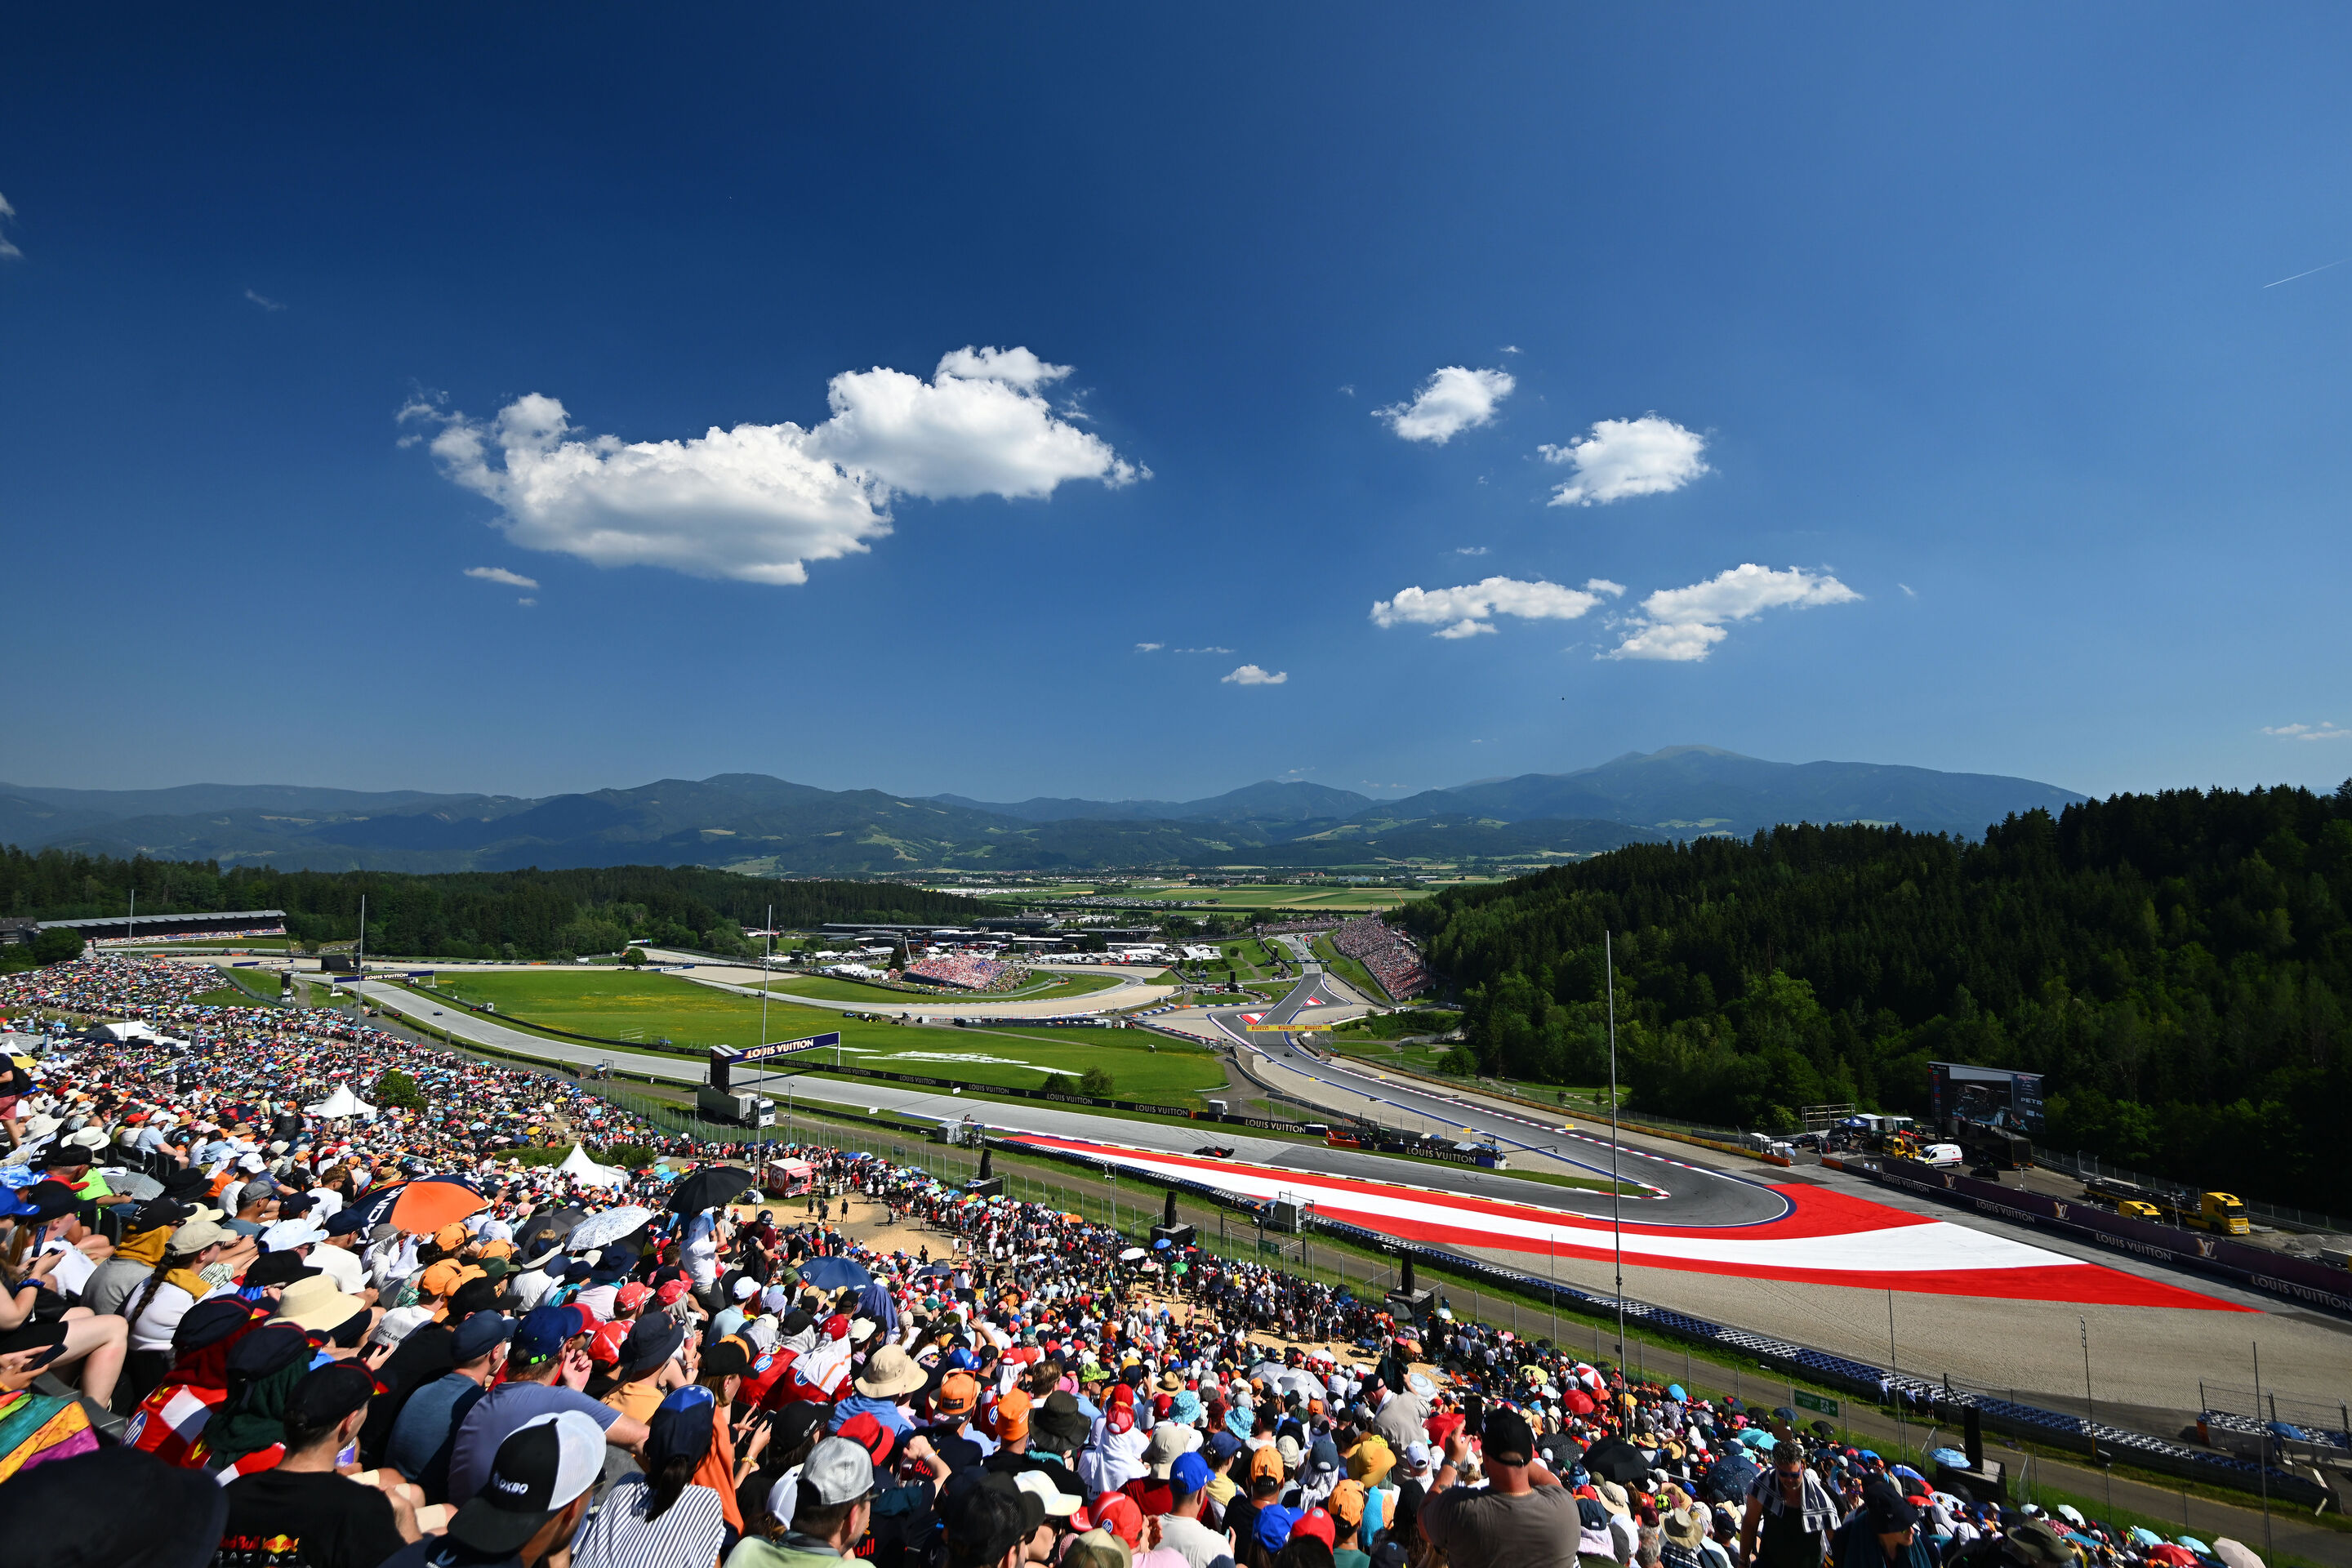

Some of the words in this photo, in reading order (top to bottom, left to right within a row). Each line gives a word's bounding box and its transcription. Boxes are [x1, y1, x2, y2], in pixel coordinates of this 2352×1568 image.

[746, 1046, 775, 1059] LOUIS
[775, 1039, 813, 1053] VUITTON
[899, 1075, 914, 1083] LOUIS
[915, 1076, 937, 1085] VUITTON
[969, 1084, 985, 1092] LOUIS
[986, 1085, 1009, 1094] VUITTON
[1046, 1093, 1065, 1102] LOUIS
[1066, 1095, 1093, 1105] VUITTON
[1135, 1103, 1156, 1113] LOUIS
[1157, 1106, 1188, 1116] VUITTON
[1245, 1118, 1268, 1129] LOUIS
[1270, 1121, 1307, 1134] VUITTON
[1406, 1147, 1434, 1158] LOUIS
[1436, 1150, 1477, 1165] VUITTON
[1882, 1174, 1901, 1185] LOUIS
[1902, 1178, 1930, 1194] VUITTON
[1976, 1200, 1999, 1214] LOUIS
[2000, 1206, 2035, 1223] VUITTON
[2096, 1232, 2125, 1249] LOUIS
[2127, 1241, 2172, 1262] VUITTON
[2251, 1275, 2289, 1294] LOUIS
[2292, 1285, 2352, 1312] VUITTON
[238, 1535, 261, 1551] Bull
[853, 1537, 875, 1557] ull
